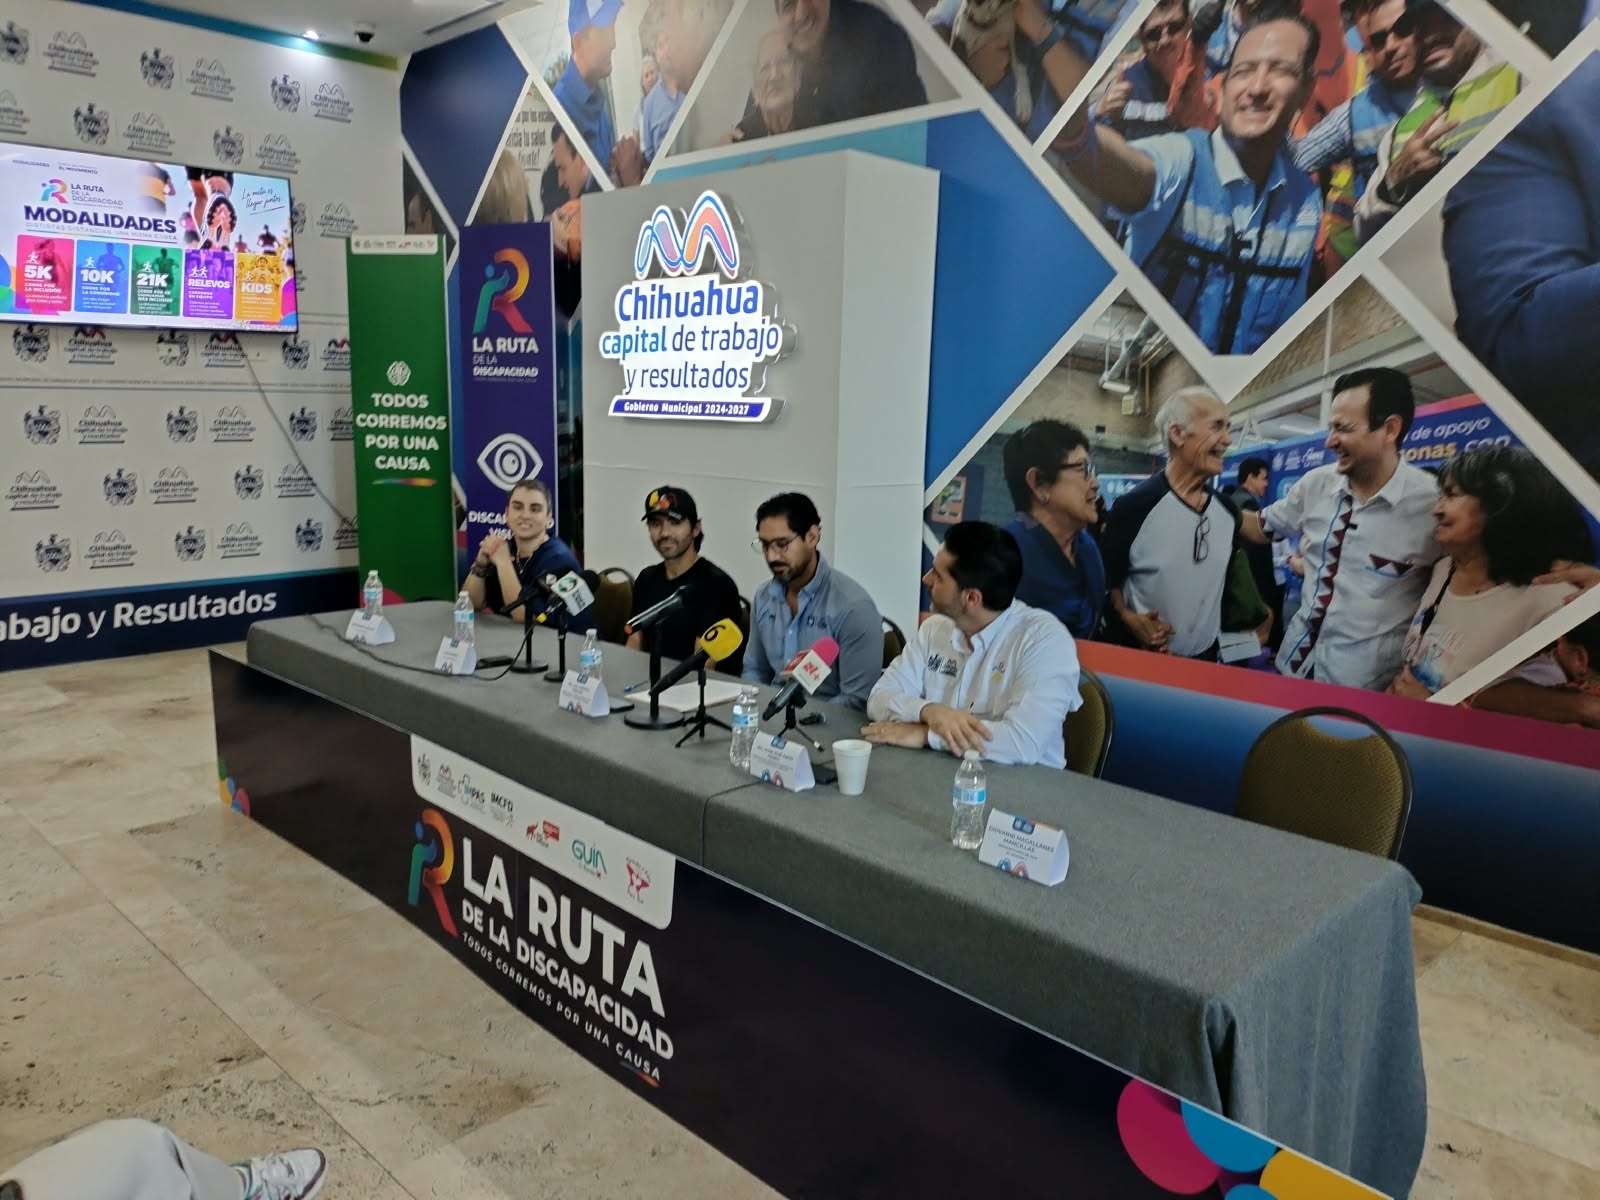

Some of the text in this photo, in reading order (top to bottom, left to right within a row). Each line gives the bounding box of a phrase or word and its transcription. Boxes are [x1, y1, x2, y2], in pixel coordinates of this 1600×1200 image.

[83, 185, 104, 193] RUTA
[24, 205, 177, 233] MODALIDADES
[24, 265, 52, 279] 5K
[80, 269, 114, 284] 10K
[136, 273, 168, 287] 21K
[188, 278, 230, 288] RELEVOS
[241, 282, 273, 293] KIDS
[618, 279, 760, 322] Chihuahua
[472, 336, 539, 354] LA RUTA
[602, 316, 779, 361] capital de trabajo
[473, 353, 497, 365] DE LA
[472, 365, 539, 378] DISCAPACIDAD
[625, 360, 749, 395] y resultados
[371, 393, 429, 408] TODOS
[624, 401, 750, 415] Gobierno Municipal 2024-2027
[356, 413, 447, 430] CORREMOS
[1410, 416, 1491, 441] de apoyo
[365, 434, 439, 451] POR UNA
[375, 455, 431, 471] CAUSA
[86, 609, 107, 639] y
[112, 589, 278, 629] Resultados
[462, 837, 514, 920] LA
[529, 875, 666, 1019] RUTA
[462, 898, 674, 1061] DE LA DISCAPACIDAD
[463, 931, 661, 1082] TODOS CORREMOS POR UNA CAUSA
